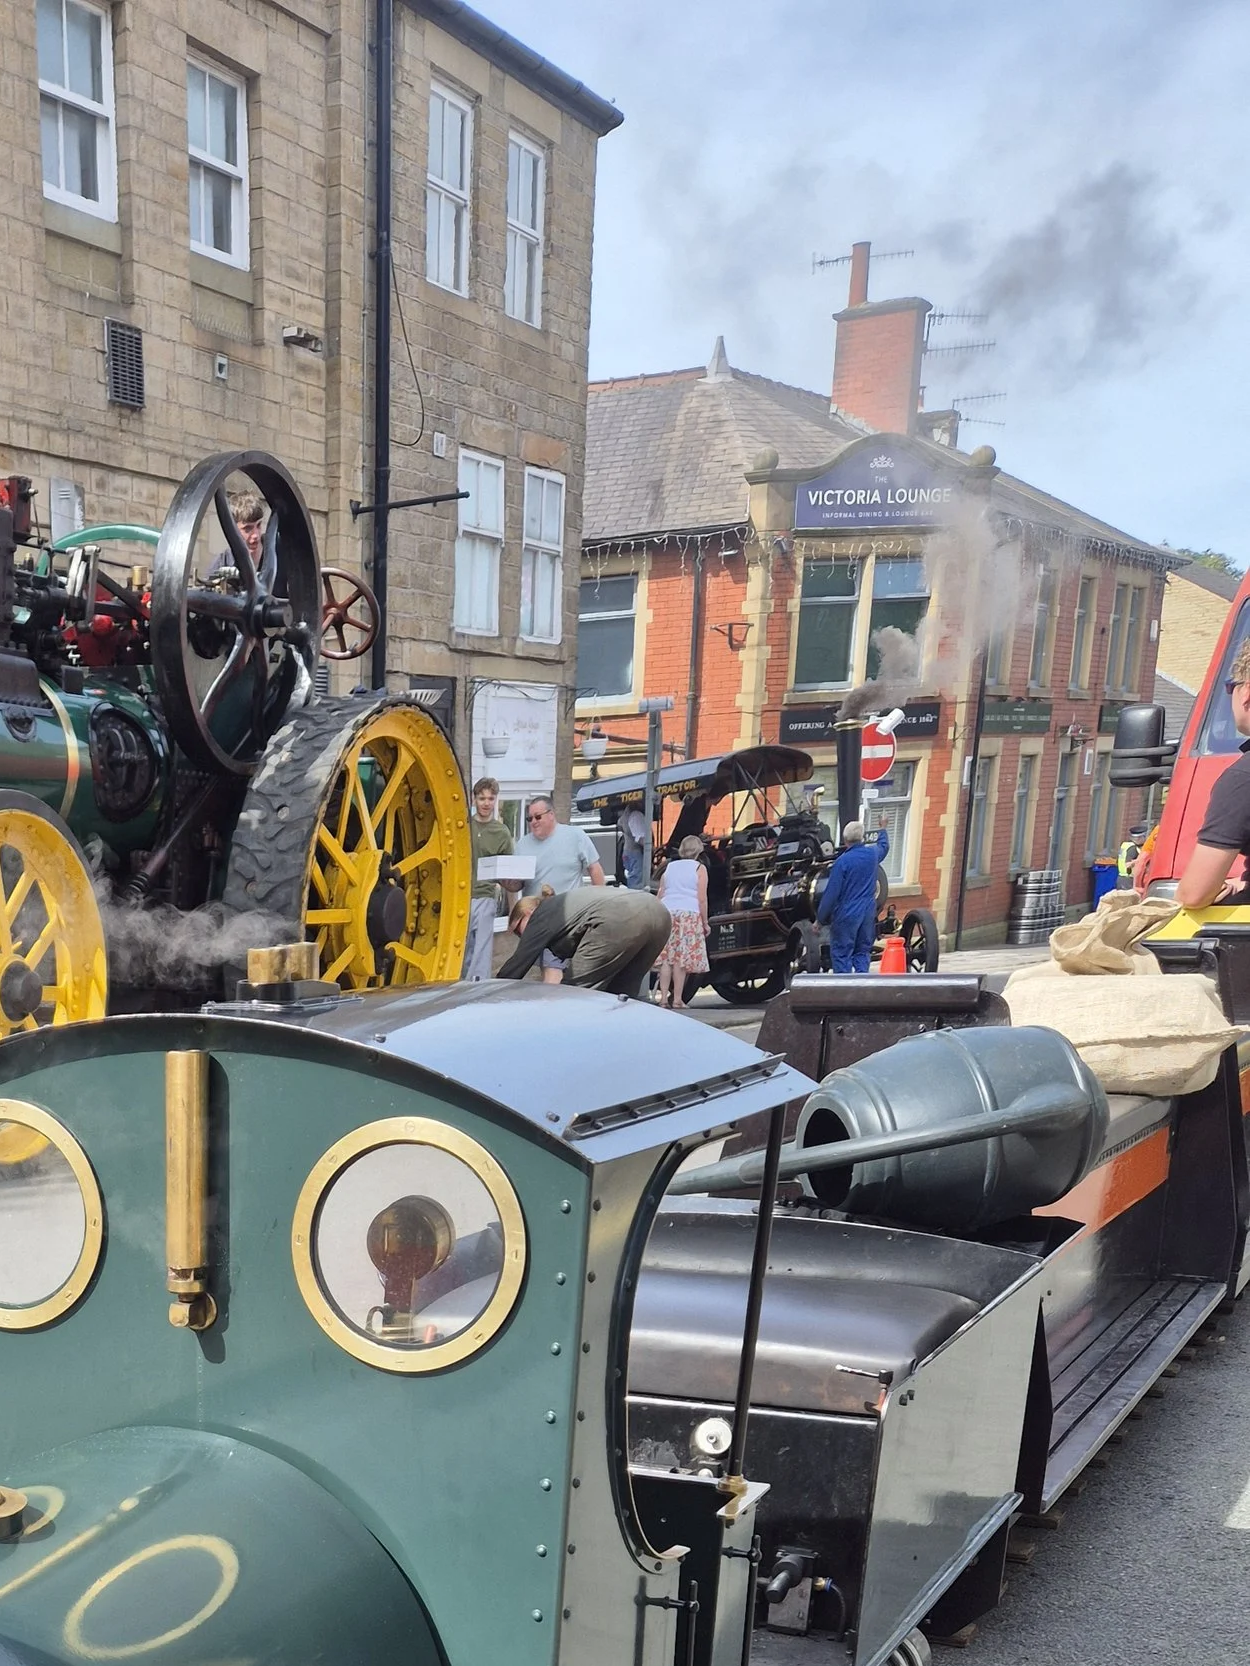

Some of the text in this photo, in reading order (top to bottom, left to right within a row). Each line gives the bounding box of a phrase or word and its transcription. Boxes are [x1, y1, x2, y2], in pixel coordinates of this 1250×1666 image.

[875, 476, 888, 484] THE
[808, 487, 952, 506] VICTORIA LOUNGE
[822, 511, 856, 519] INFORMAL
[788, 722, 825, 730] OFFERING
[593, 797, 608, 808] THE
